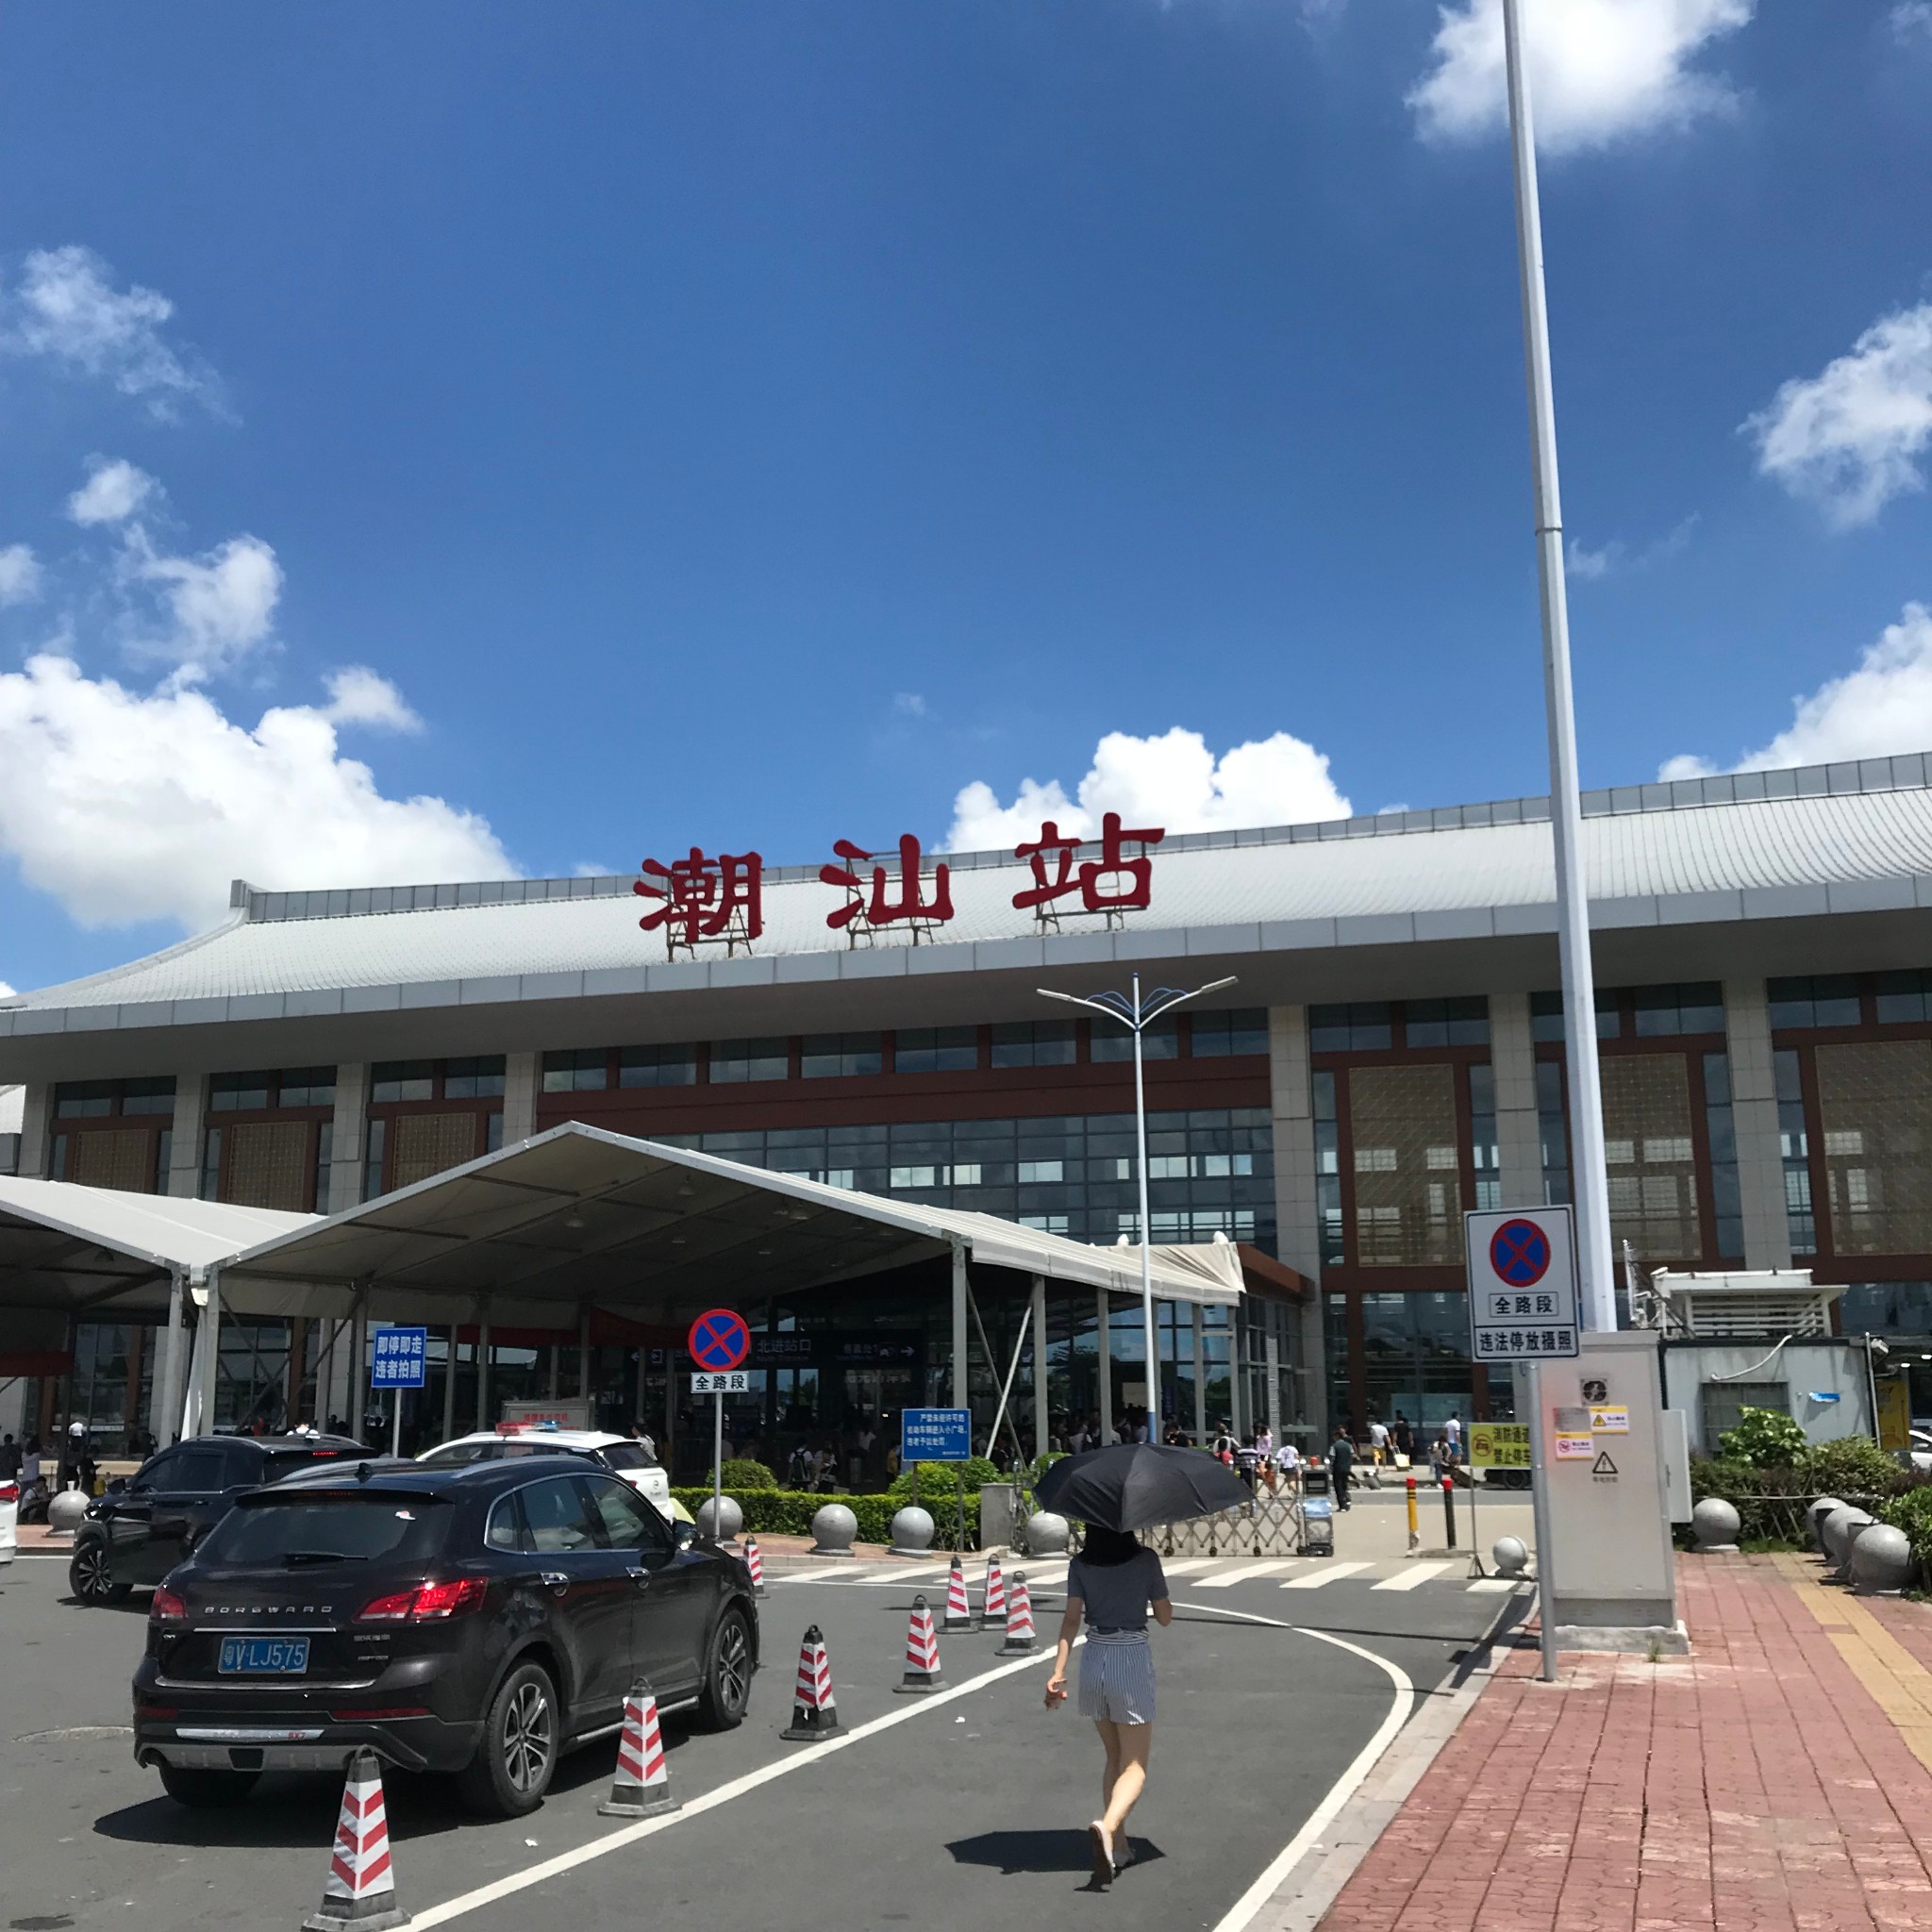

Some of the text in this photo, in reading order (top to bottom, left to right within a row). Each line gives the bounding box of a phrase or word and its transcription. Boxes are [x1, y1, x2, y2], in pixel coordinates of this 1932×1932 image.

[633, 811, 1165, 943] 潮汕站
[1495, 1295, 1553, 1314] 全路段
[377, 1335, 422, 1355] 即停即走
[1479, 1330, 1573, 1352] 违法停放摄照
[375, 1359, 421, 1379] 违者拍照
[695, 1374, 744, 1390] 全路段
[1494, 1448, 1531, 1465] 禁止停车
[205, 1606, 332, 1614] BORGWARD
